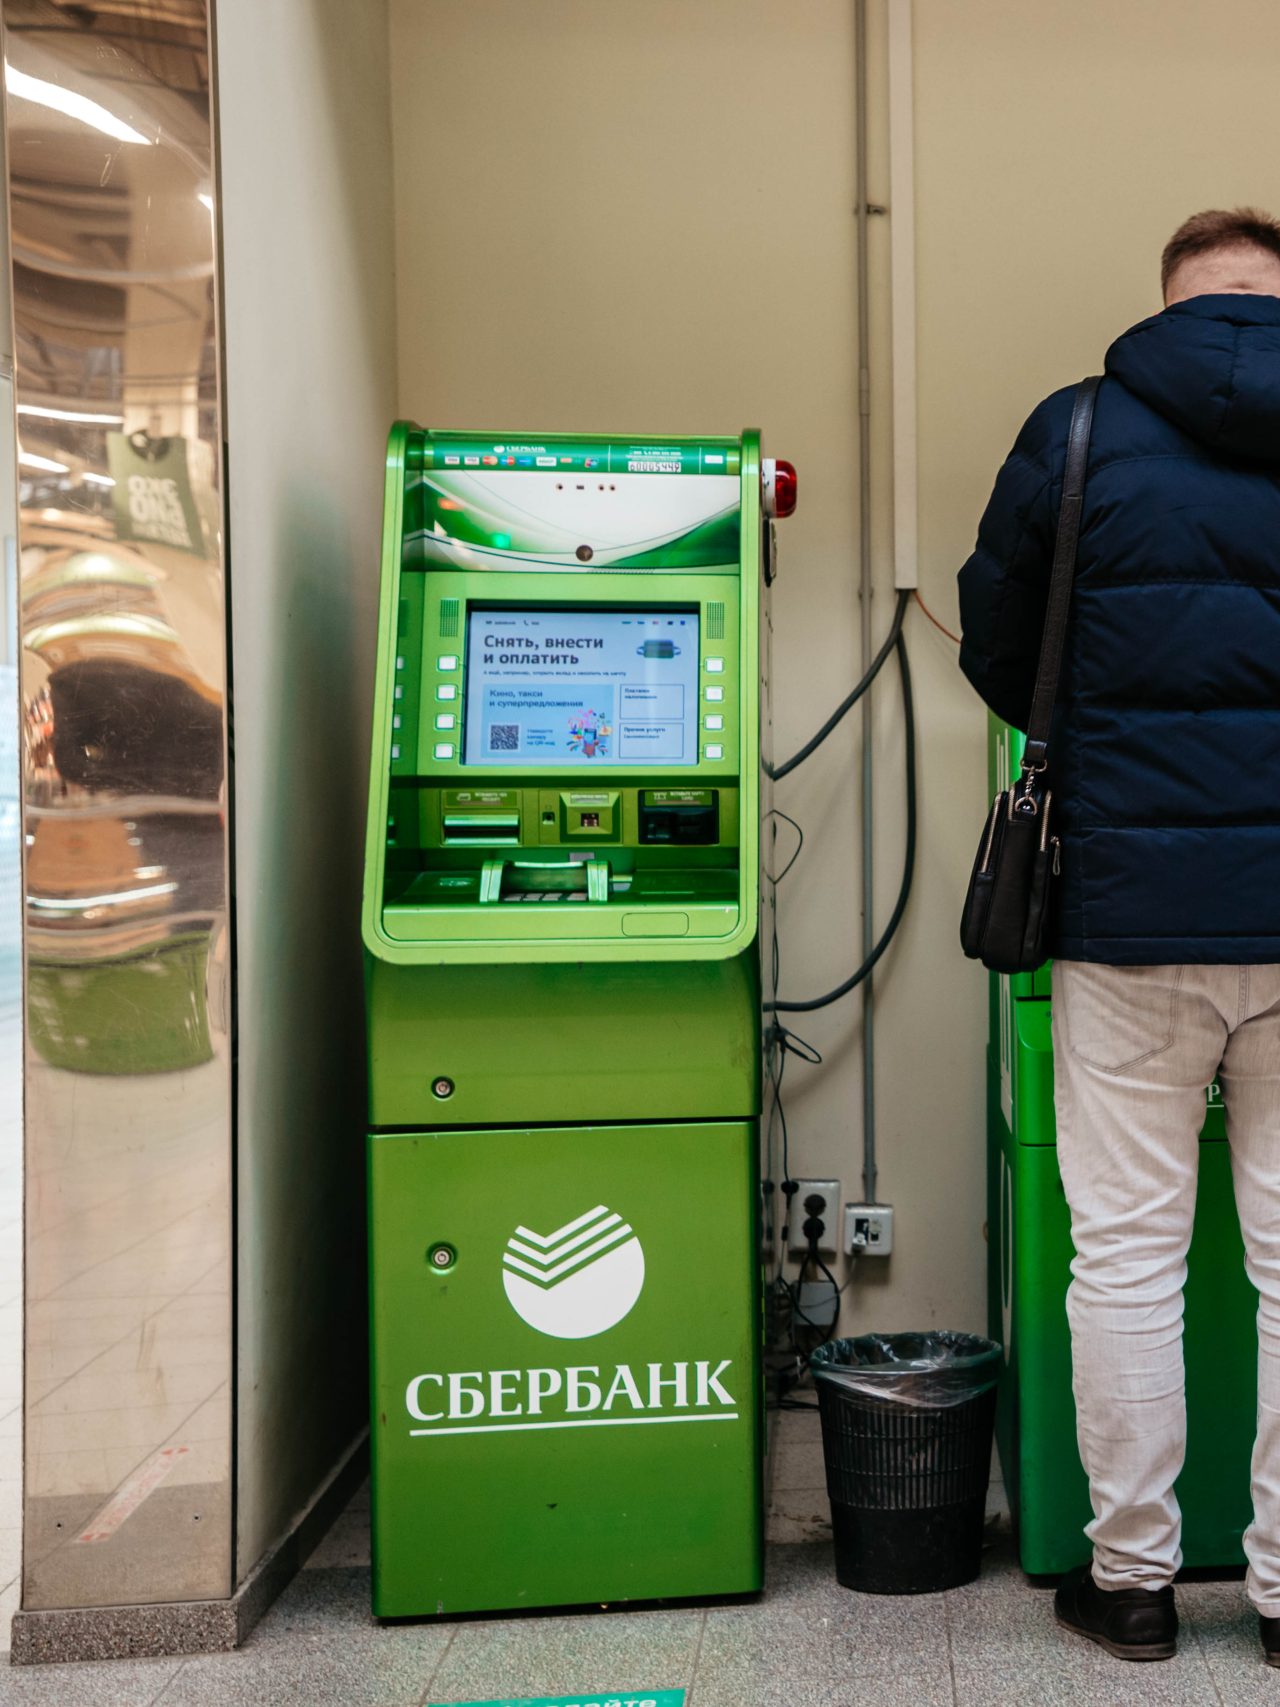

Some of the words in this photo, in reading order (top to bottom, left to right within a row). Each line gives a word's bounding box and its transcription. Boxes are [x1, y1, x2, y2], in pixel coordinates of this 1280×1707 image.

[484, 635, 540, 650] Снять,
[545, 638, 604, 649] внести
[484, 654, 494, 664] и
[499, 654, 579, 664] оплатить
[405, 1360, 737, 1421] СБЕРБАНК
